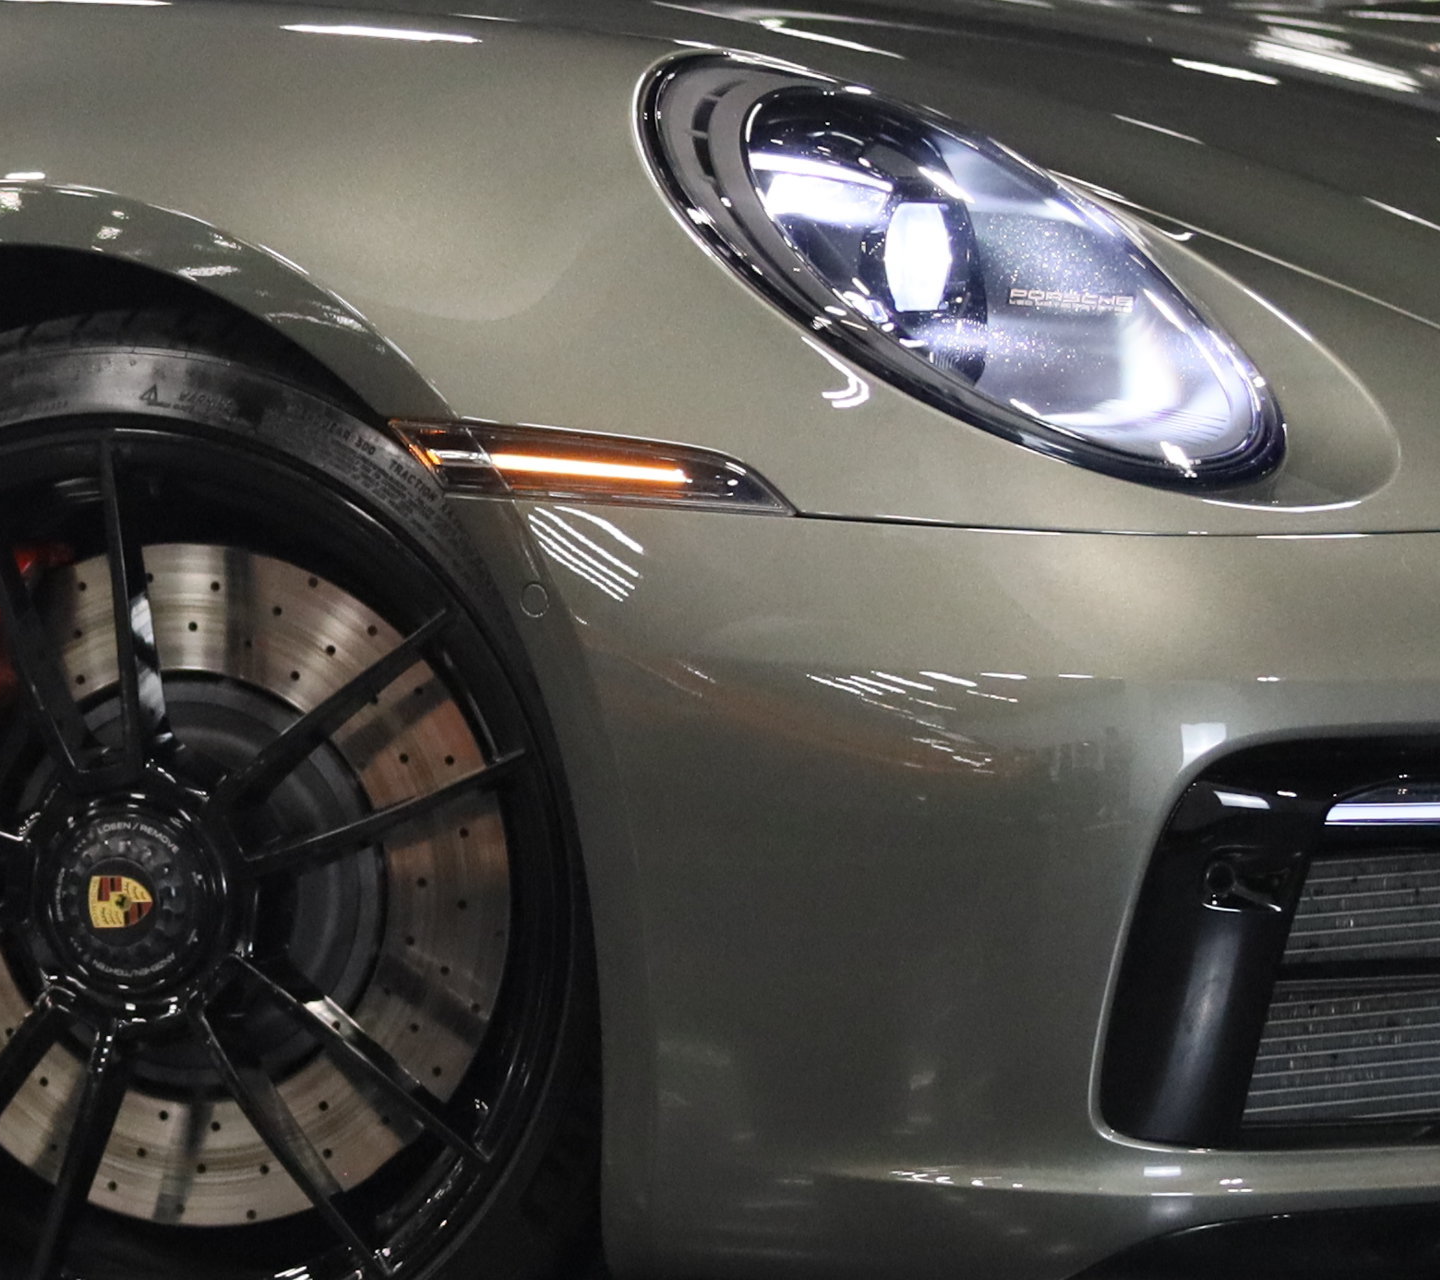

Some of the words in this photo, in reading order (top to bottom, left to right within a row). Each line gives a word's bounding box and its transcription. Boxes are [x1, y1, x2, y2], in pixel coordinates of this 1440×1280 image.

[1009, 288, 1134, 307] PORSCHE
[387, 457, 439, 503] TRACTION
[140, 824, 180, 854] REMOVE
